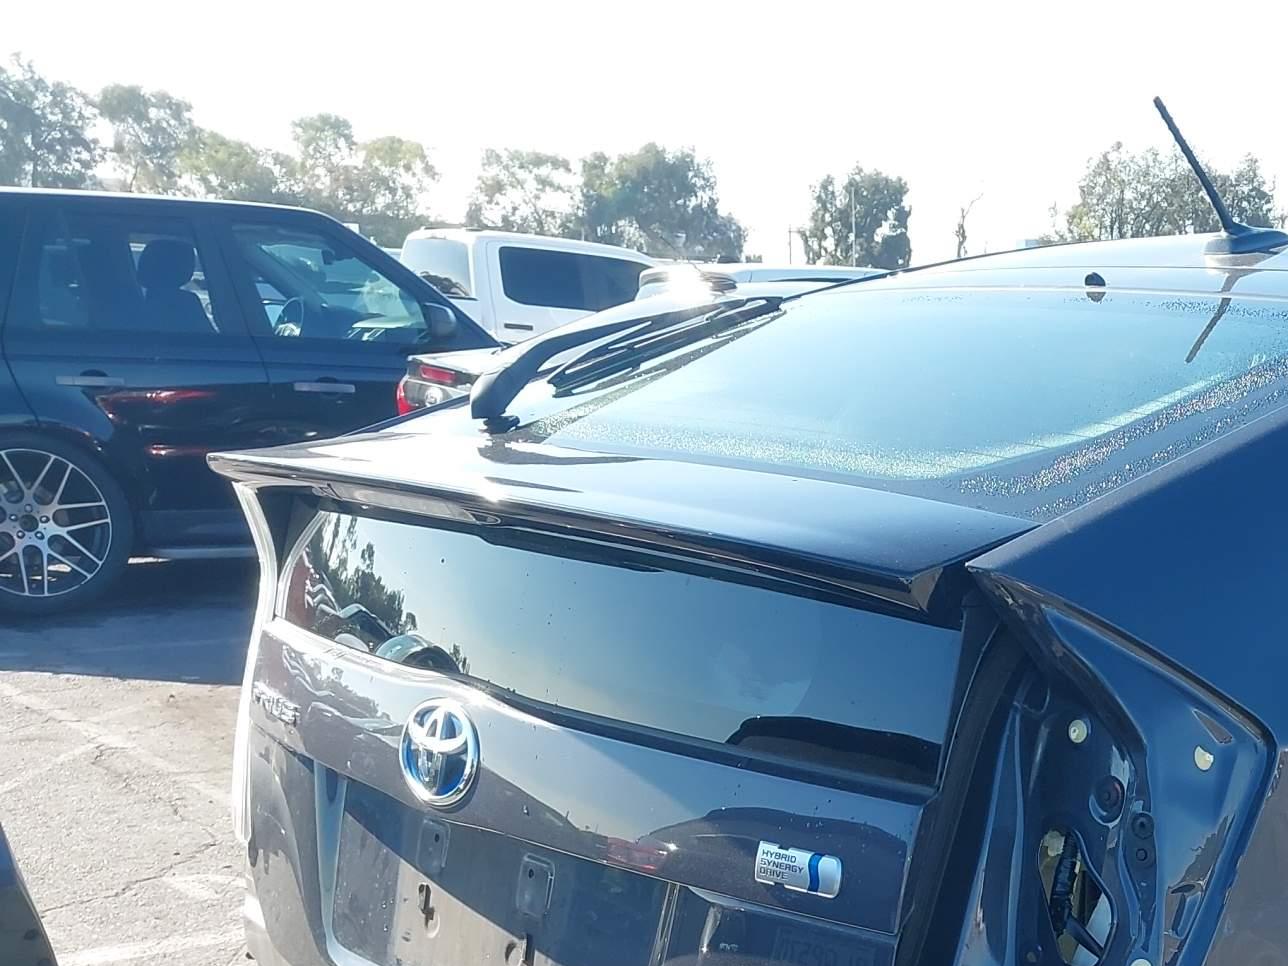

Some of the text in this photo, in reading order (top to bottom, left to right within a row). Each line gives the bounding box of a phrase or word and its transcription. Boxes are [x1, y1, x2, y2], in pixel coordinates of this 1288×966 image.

[761, 848, 797, 863] HYBRID
[759, 866, 788, 880] DRIVE
[760, 857, 804, 875] SYNERGY
